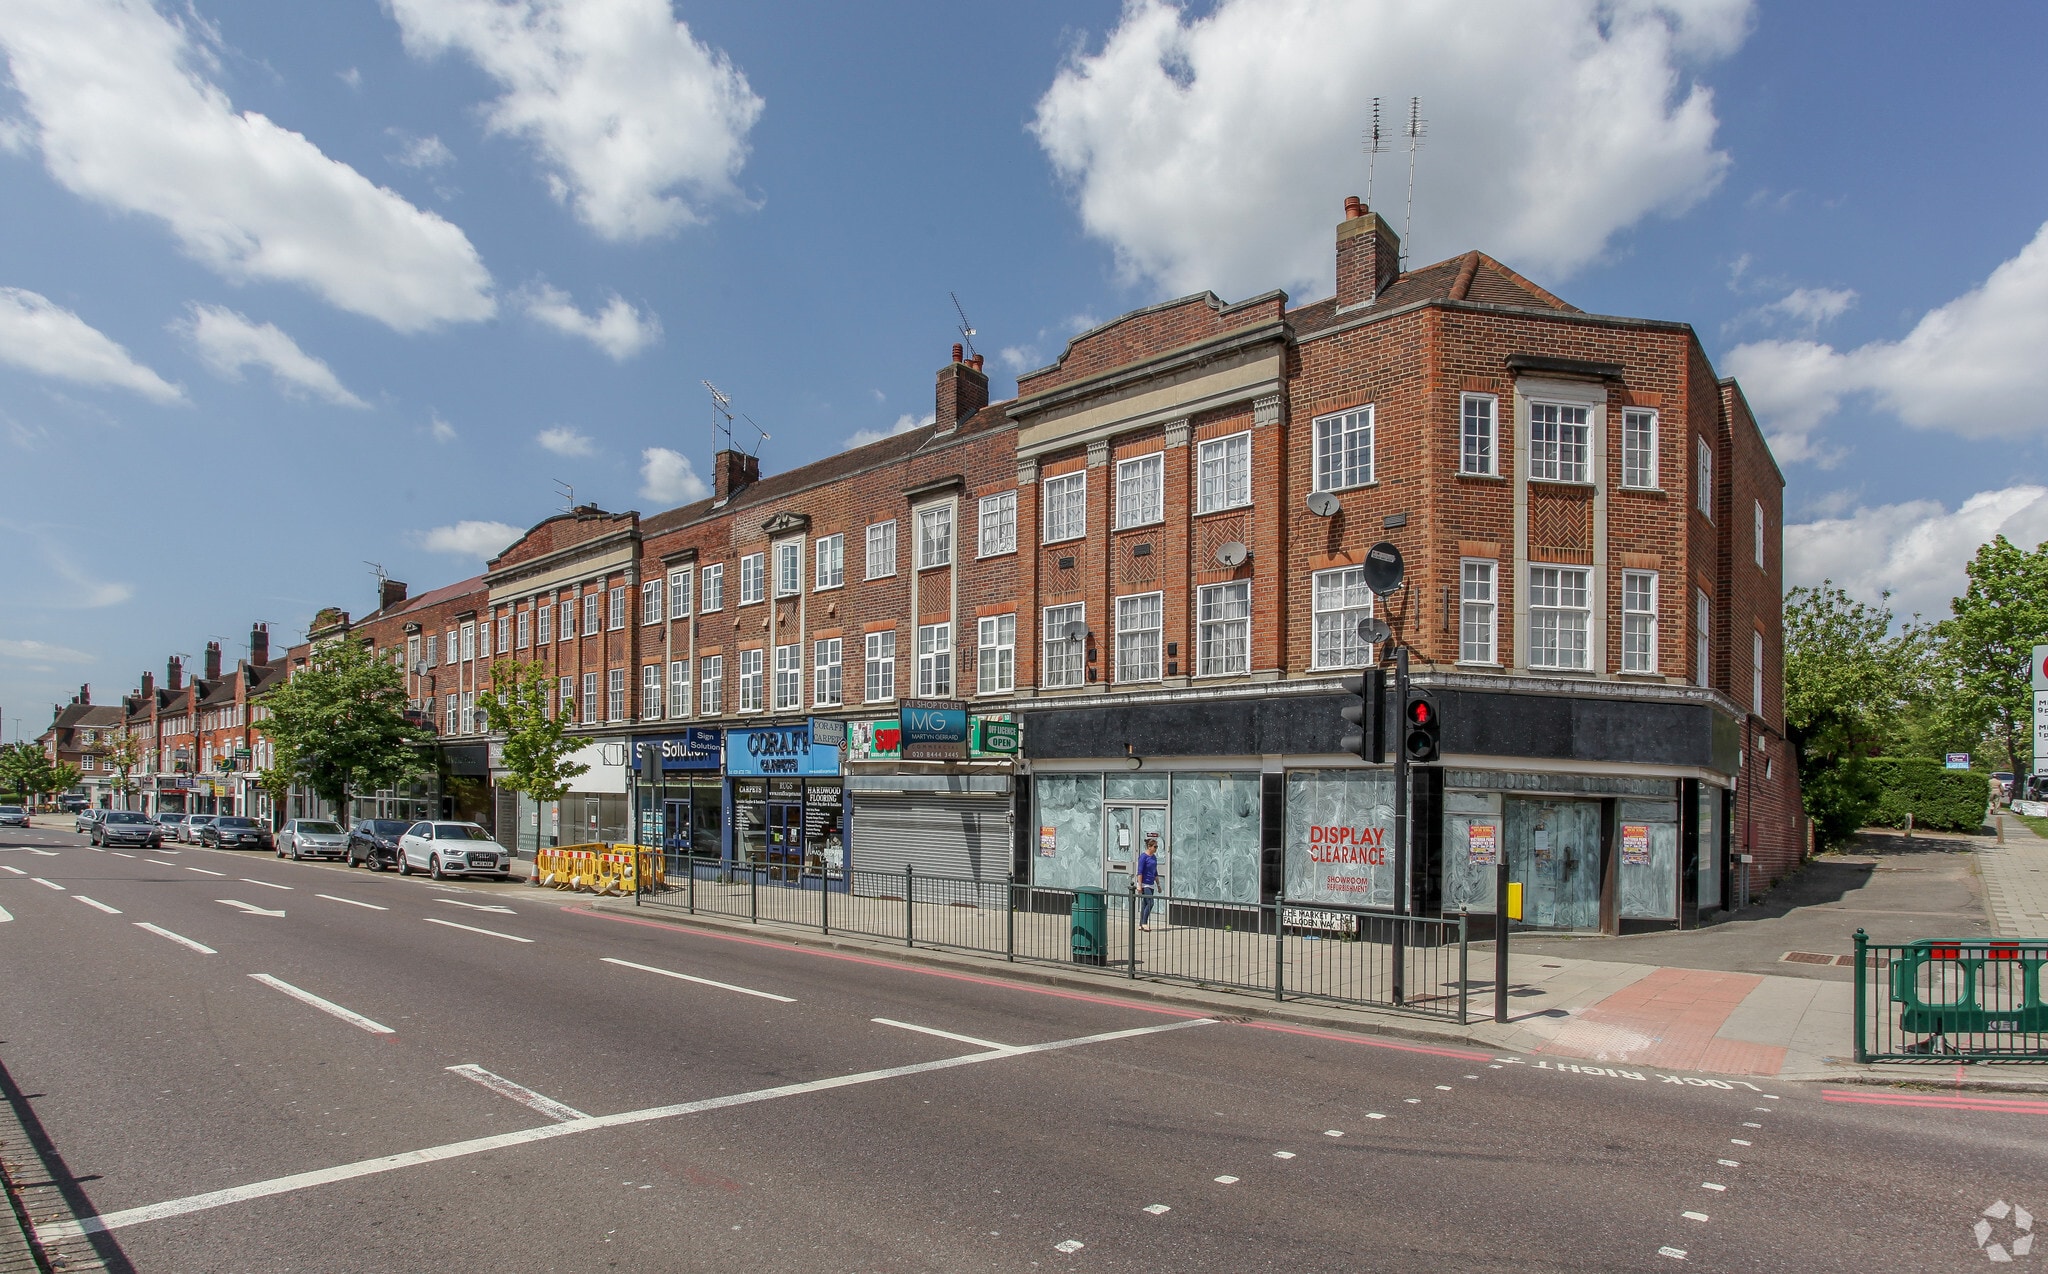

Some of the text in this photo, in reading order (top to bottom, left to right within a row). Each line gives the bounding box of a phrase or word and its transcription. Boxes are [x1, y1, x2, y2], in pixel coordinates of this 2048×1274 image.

[916, 701, 938, 709] SHOP
[938, 702, 949, 710] TO
[911, 711, 946, 731] MG
[814, 721, 844, 732] CORAFF
[988, 725, 1016, 736] OFF LICENCE
[697, 731, 714, 740] Sign
[814, 734, 842, 746] CARPET
[690, 741, 720, 751] Solution
[992, 738, 1011, 747] OPEN
[739, 785, 762, 794] CARPETS
[779, 782, 793, 790] RUGS
[807, 786, 841, 795] HARDWOOD
[809, 794, 837, 802] FLOORING
[1310, 825, 1385, 846] DISPLAY
[1310, 844, 1385, 866] CLEARANCE
[1327, 875, 1368, 885] SHOWROOM
[1326, 883, 1368, 893] REFURBISHMENT
[1283, 908, 1354, 923] THE MARKET PLACE
[1283, 917, 1318, 927] FALLODEN
[1531, 1061, 1647, 1081] RIGHT
